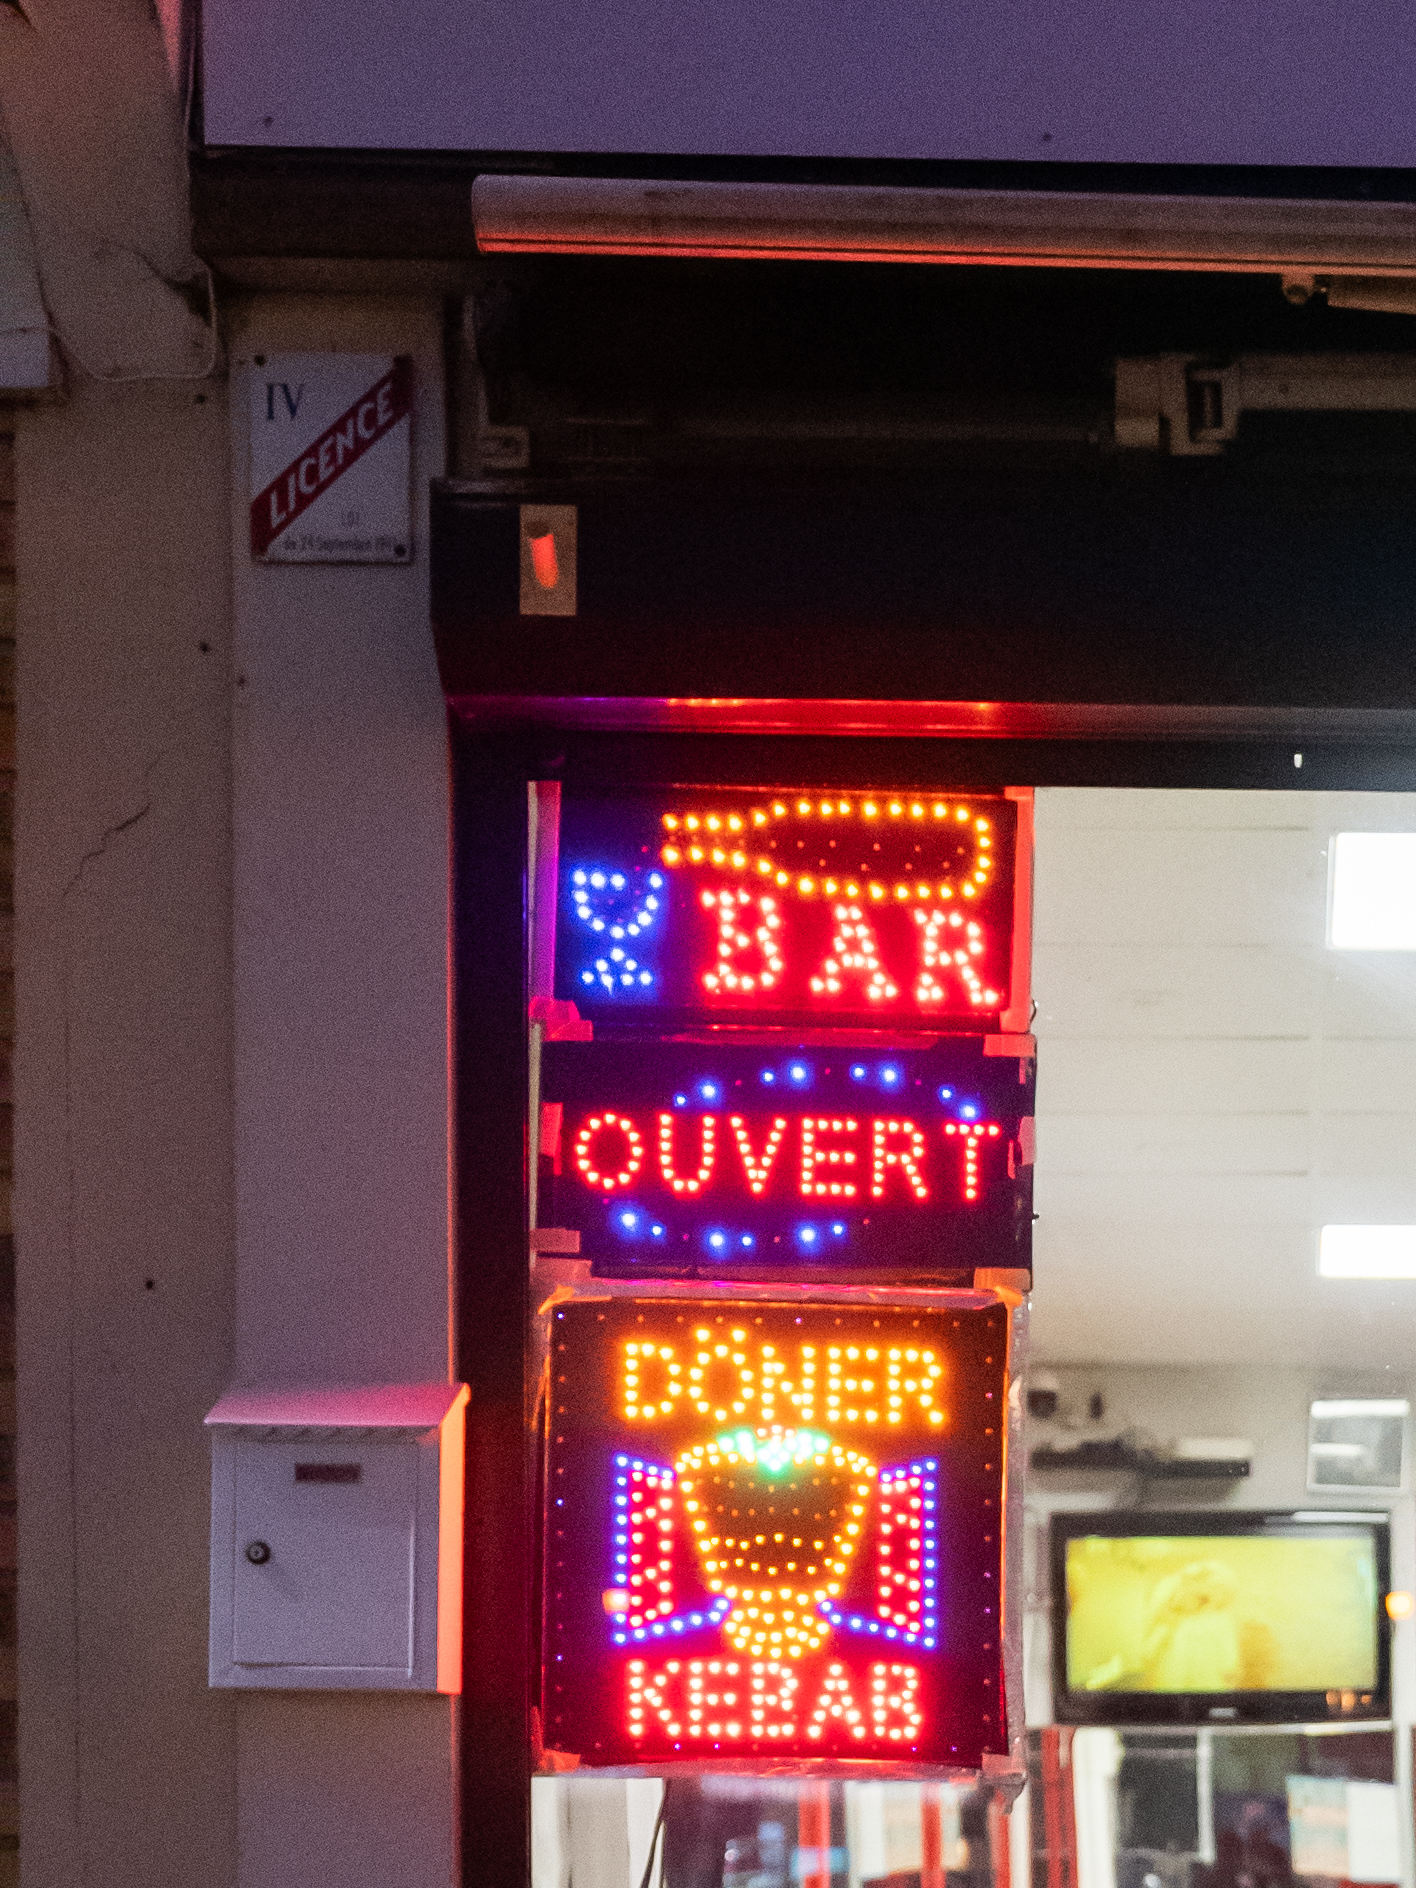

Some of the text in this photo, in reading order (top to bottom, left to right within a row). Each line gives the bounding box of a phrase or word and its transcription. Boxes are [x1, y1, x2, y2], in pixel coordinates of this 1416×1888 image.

[265, 382, 304, 421] IV
[269, 381, 394, 529] LICENCE
[698, 888, 1001, 1009] BAR
[573, 1112, 1002, 1201] OUVERT
[621, 1326, 945, 1425] DÖNER
[627, 1659, 924, 1741] KEBAB
